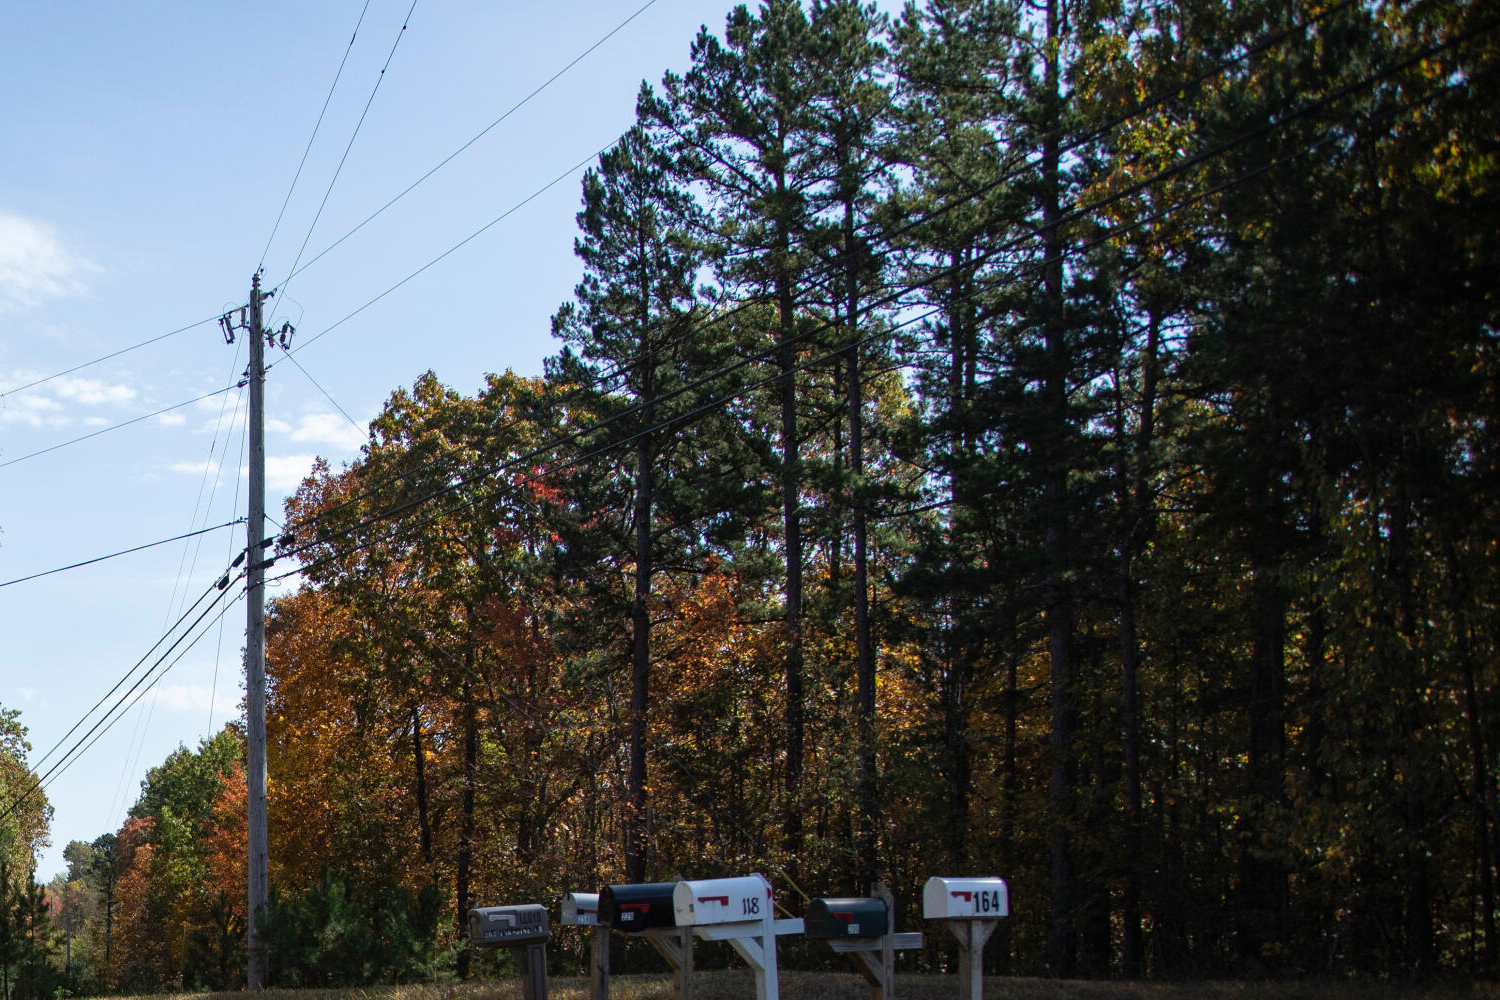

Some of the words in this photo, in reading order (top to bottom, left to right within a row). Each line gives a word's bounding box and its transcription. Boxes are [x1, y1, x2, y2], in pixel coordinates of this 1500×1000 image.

[742, 897, 759, 916] 118
[973, 890, 999, 913] 164
[519, 910, 542, 925] LLOYD
